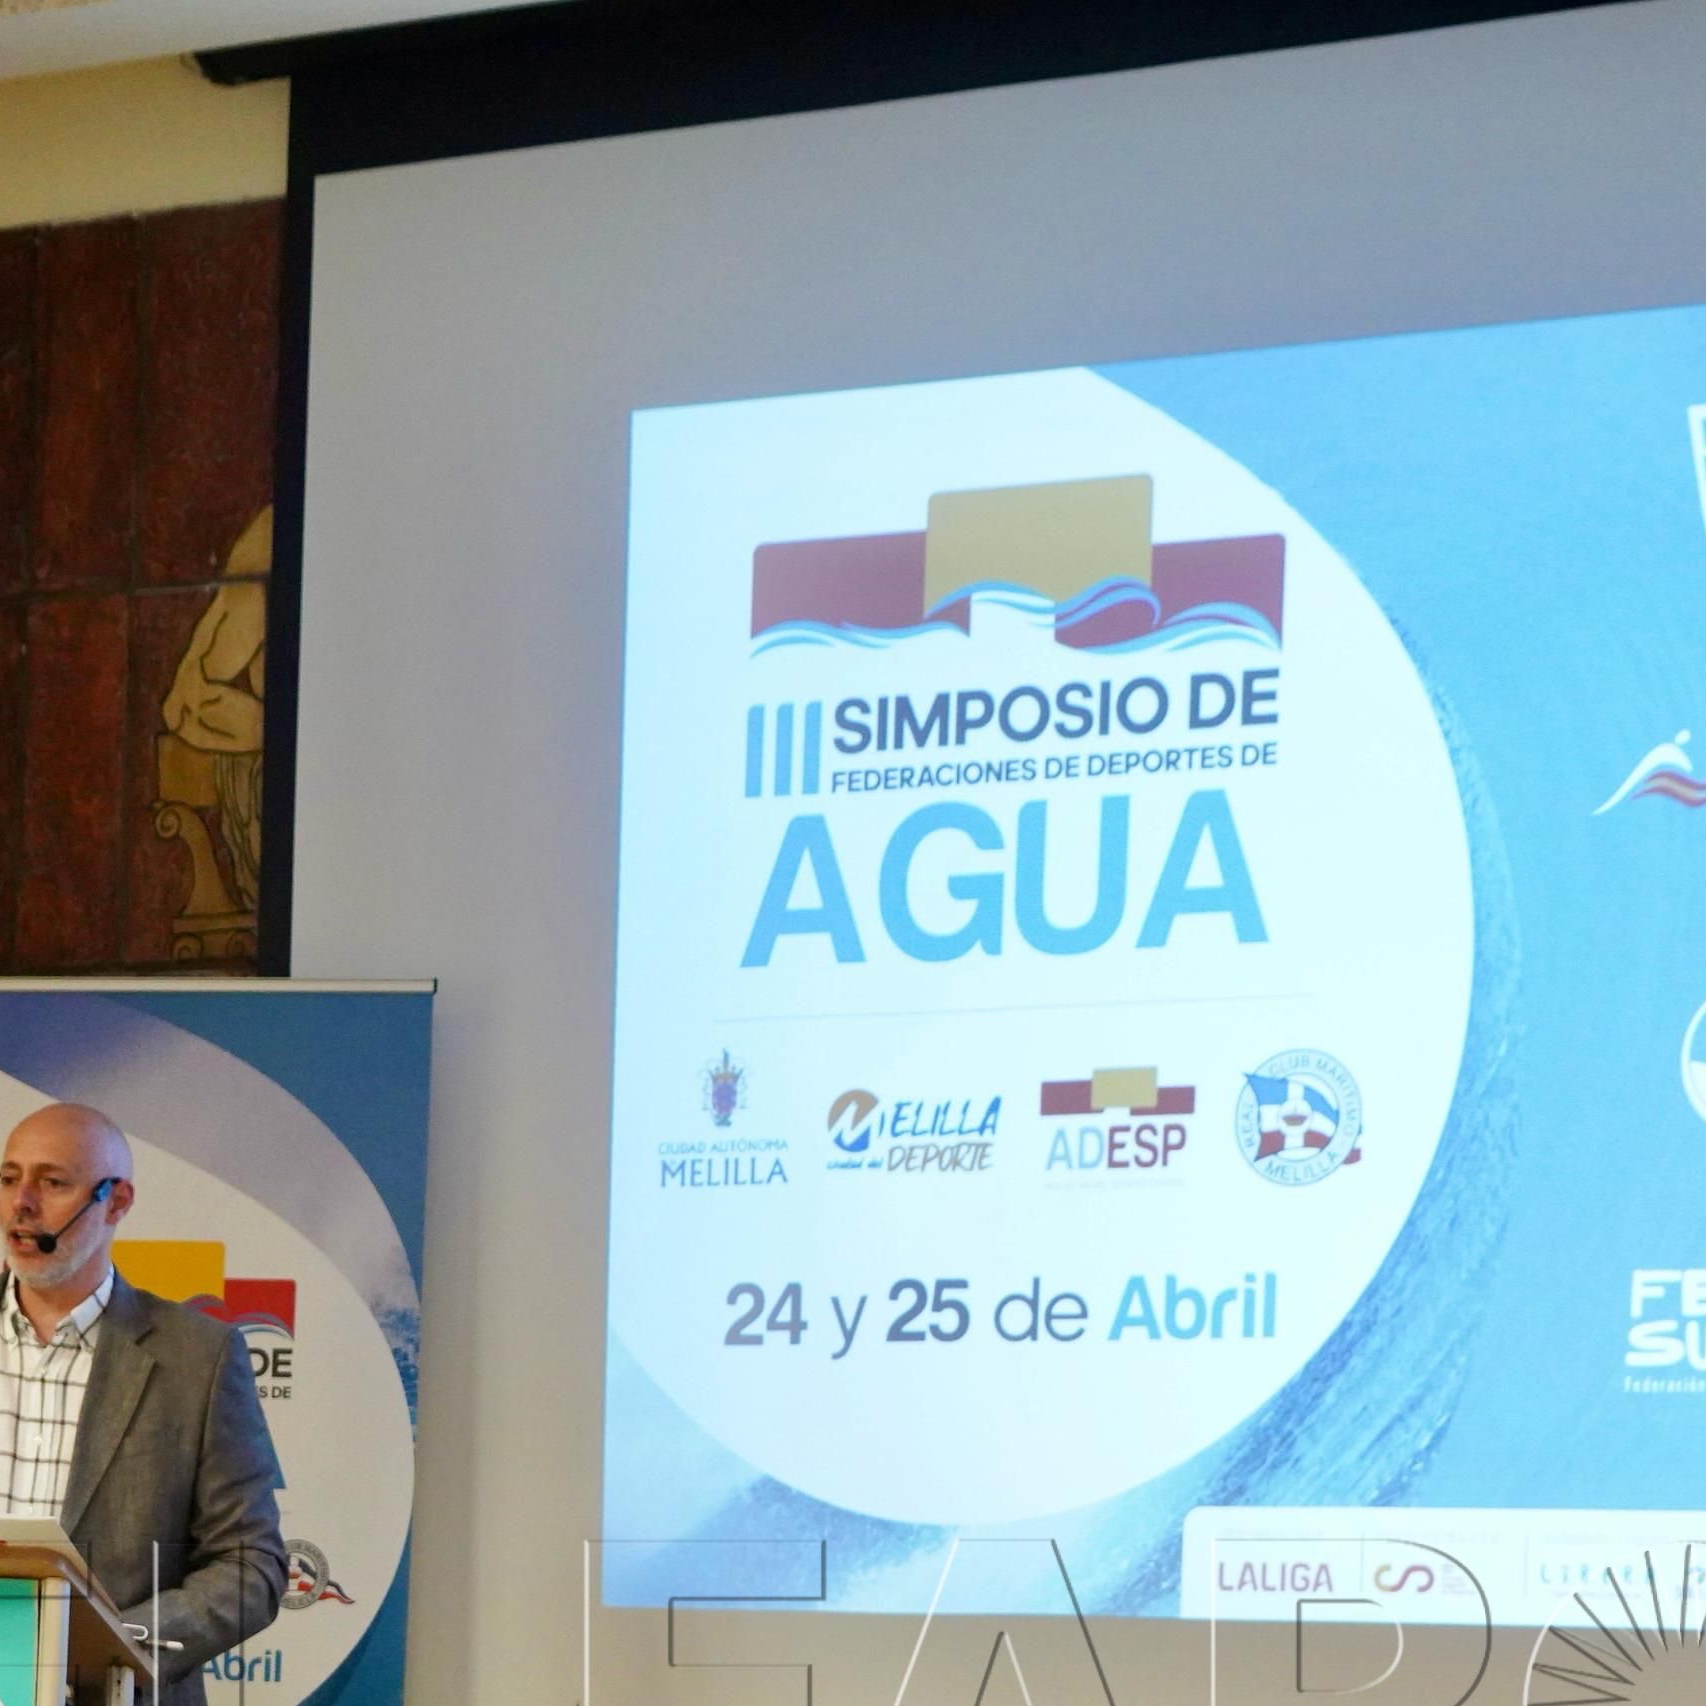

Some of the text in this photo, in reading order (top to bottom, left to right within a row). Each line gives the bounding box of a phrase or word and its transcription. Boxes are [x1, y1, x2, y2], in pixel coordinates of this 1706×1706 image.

[833, 668, 1280, 754] SIMPOSIO DE
[745, 701, 822, 797] III
[831, 742, 1278, 793] FEDERACIONES DE DEPORTES DE
[740, 788, 1270, 968] AGUA
[660, 1156, 789, 1188] MELILLA
[887, 1142, 995, 1172] DEPORTE
[1045, 1124, 1188, 1171] ADESP
[724, 1272, 1278, 1360] 24 y 25 de Abril
[271, 1385, 292, 1399] DE
[1218, 1561, 1334, 1593] LALIGA
